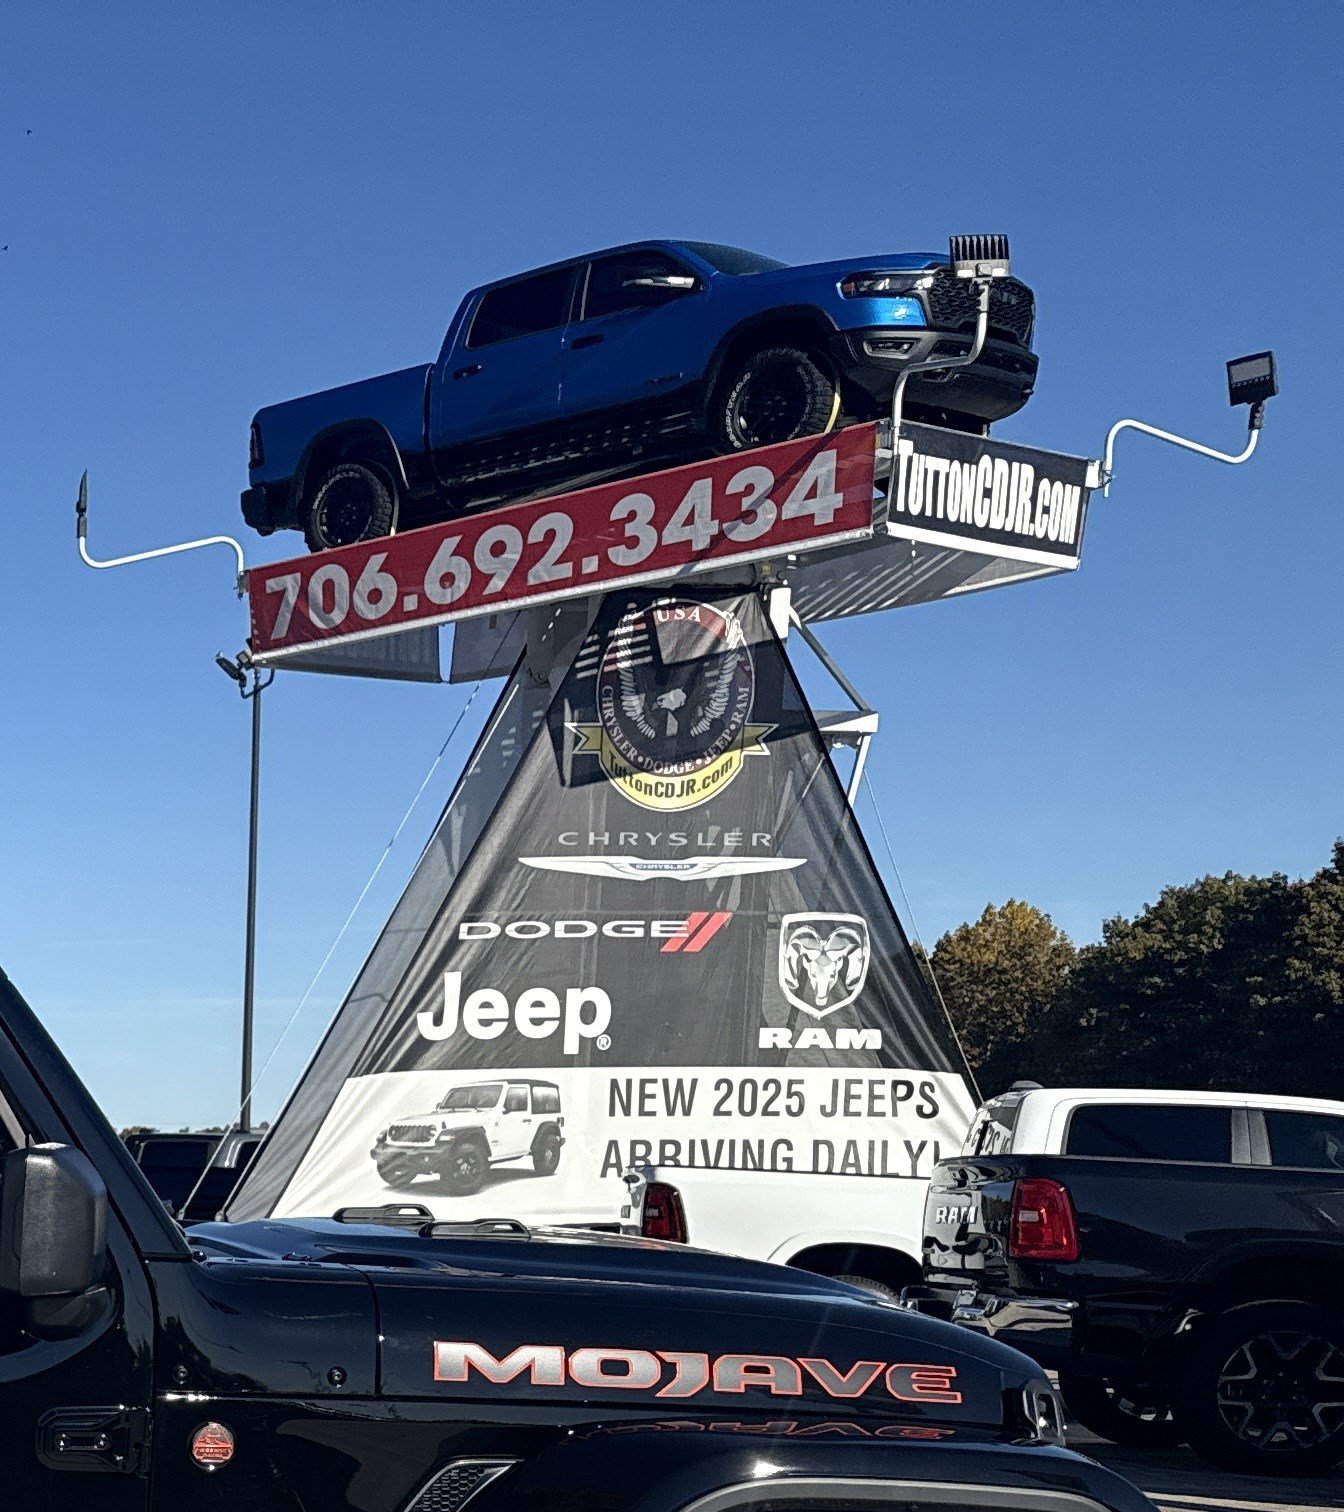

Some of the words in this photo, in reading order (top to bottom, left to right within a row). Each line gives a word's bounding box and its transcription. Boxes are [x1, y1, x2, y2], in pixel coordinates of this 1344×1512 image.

[265, 450, 843, 641] 706.692.3434
[656, 606, 701, 622] USA
[602, 685, 643, 760] CHRYSLER
[644, 757, 695, 775] DODGE
[732, 686, 750, 724] RAM
[609, 755, 734, 798] TuttonCDJR.com
[558, 831, 772, 847] CHRYSLER
[458, 920, 689, 940] DODGE
[758, 1027, 882, 1050] RAM
[608, 1077, 699, 1117] NEW
[712, 1077, 806, 1117] 2025
[820, 1077, 940, 1119] JEEPS
[936, 1206, 978, 1225] RAM
[433, 1340, 962, 1404] MOJAVE
